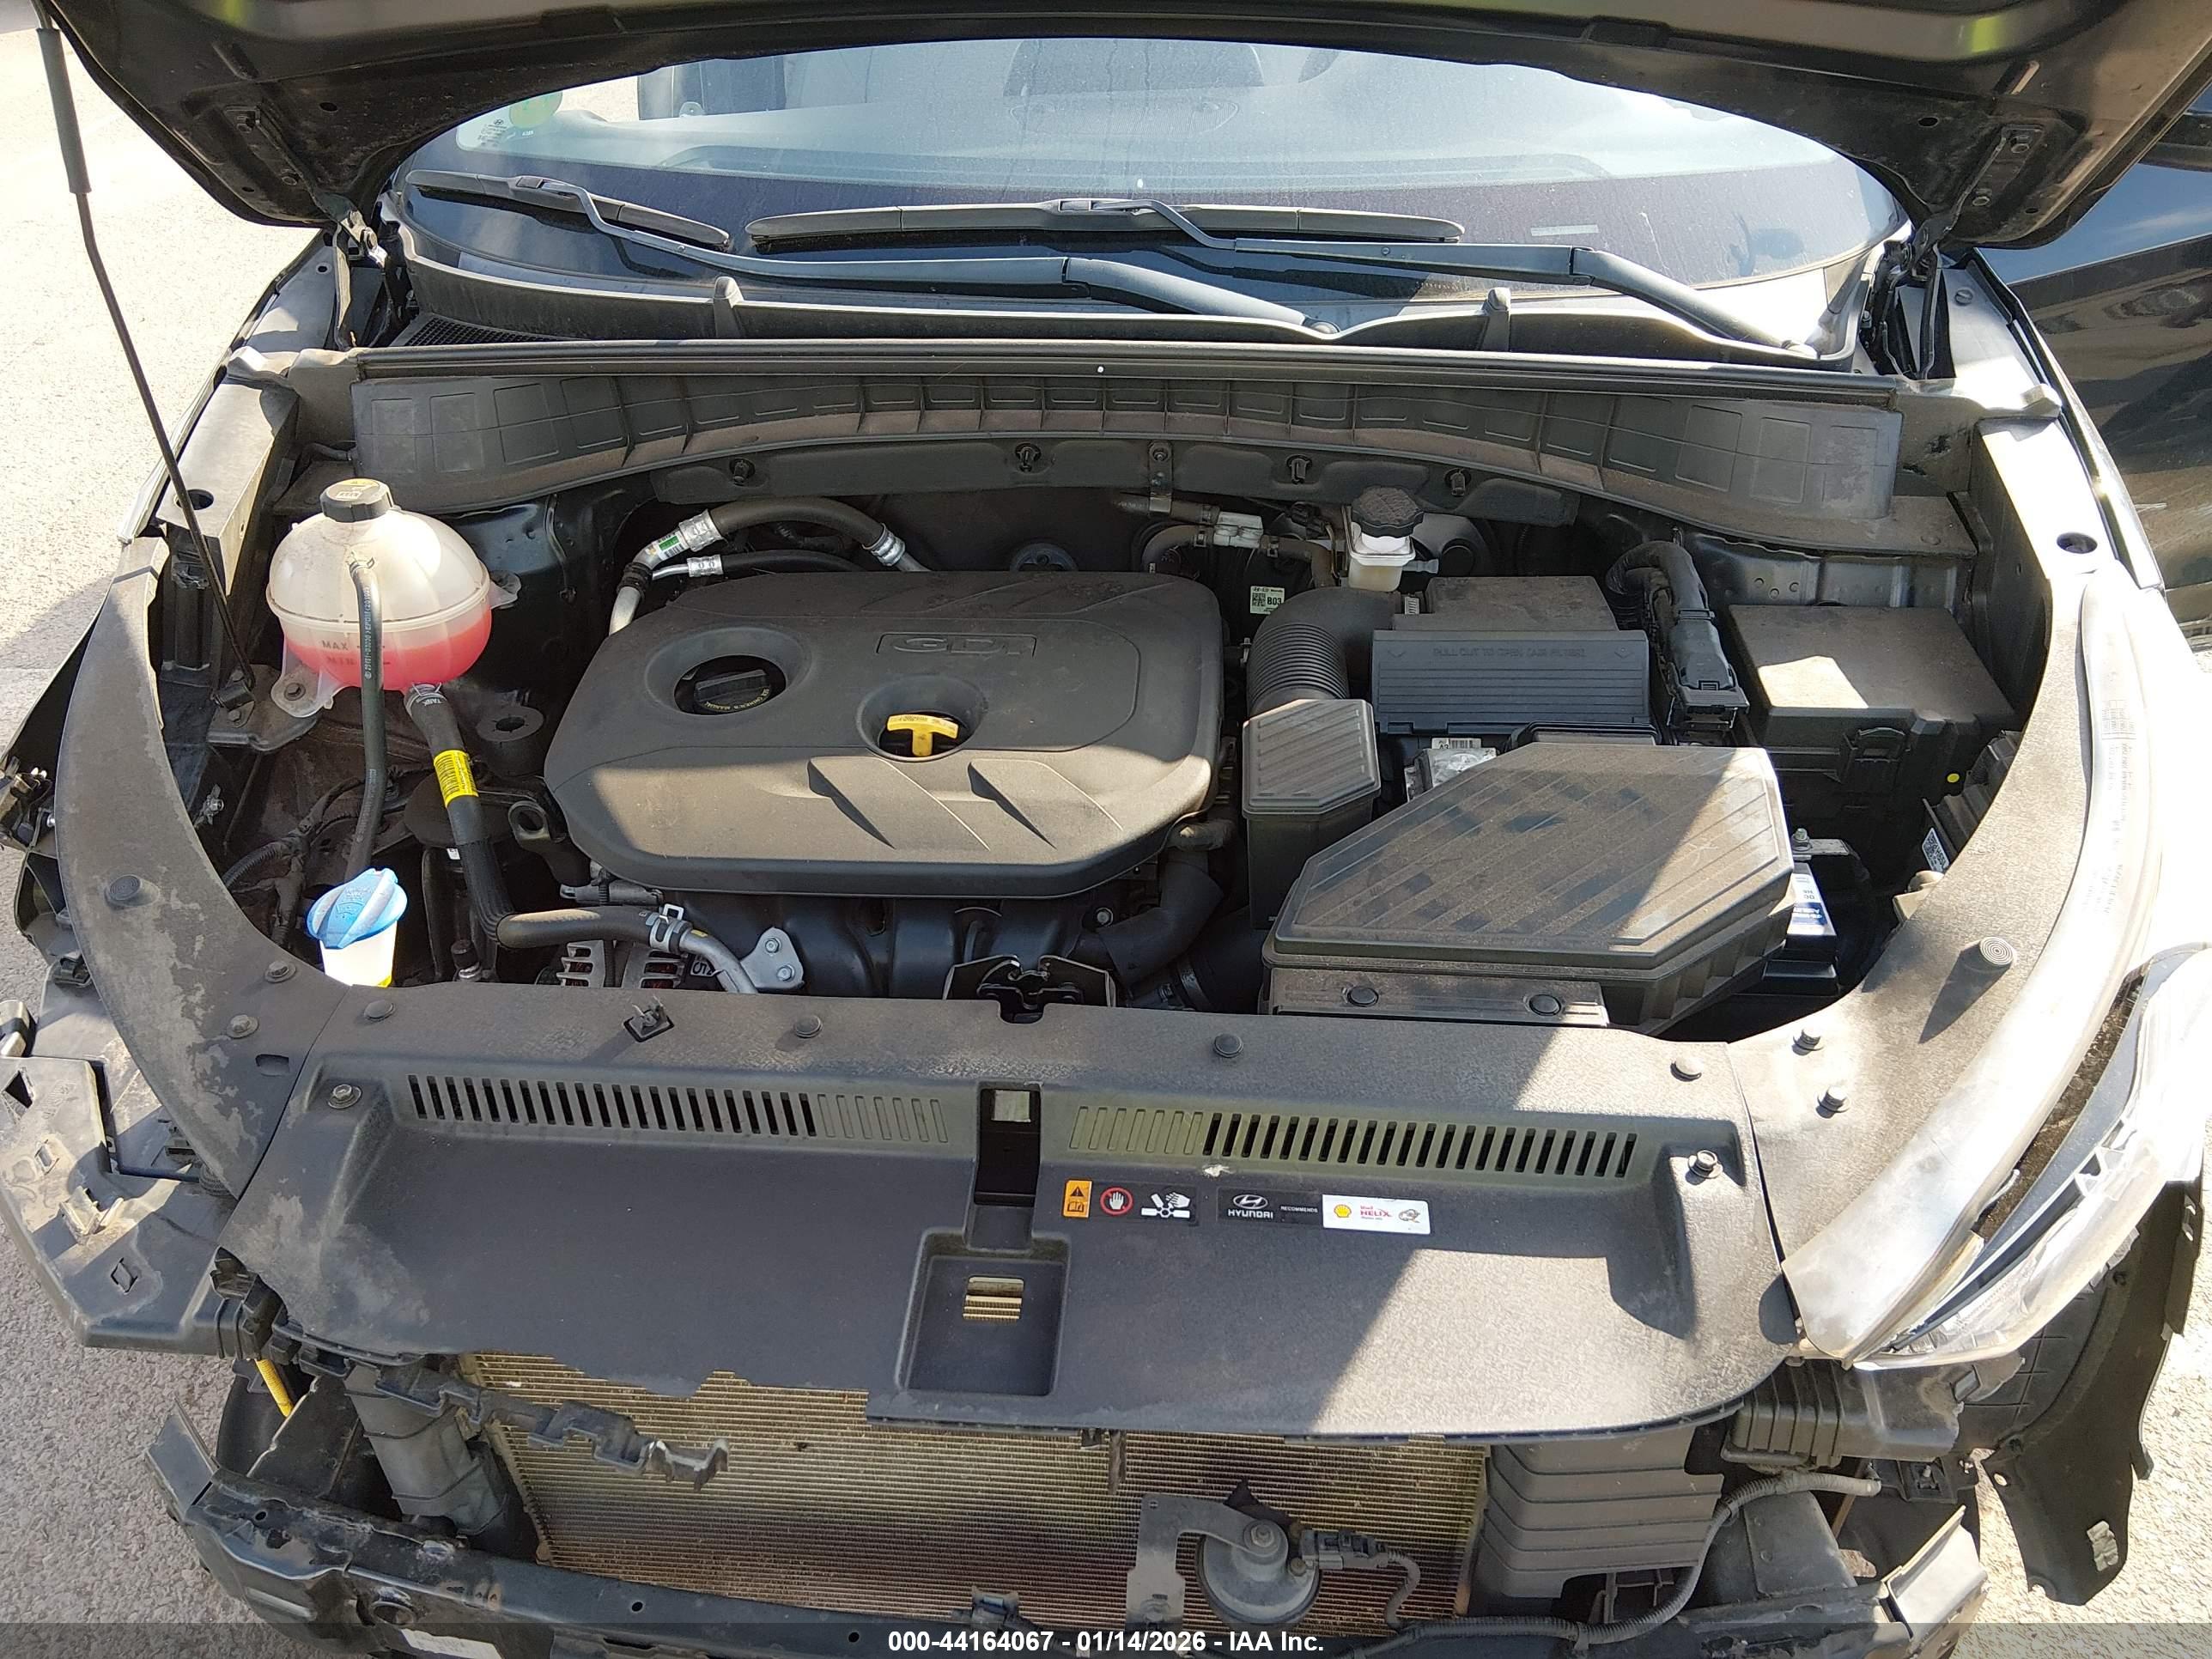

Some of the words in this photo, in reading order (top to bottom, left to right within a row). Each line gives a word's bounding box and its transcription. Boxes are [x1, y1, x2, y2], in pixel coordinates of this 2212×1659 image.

[322, 640, 349, 650] MAX
[1228, 1209, 1273, 1219] HYUNDAI
[1360, 1209, 1390, 1218] HELIX
